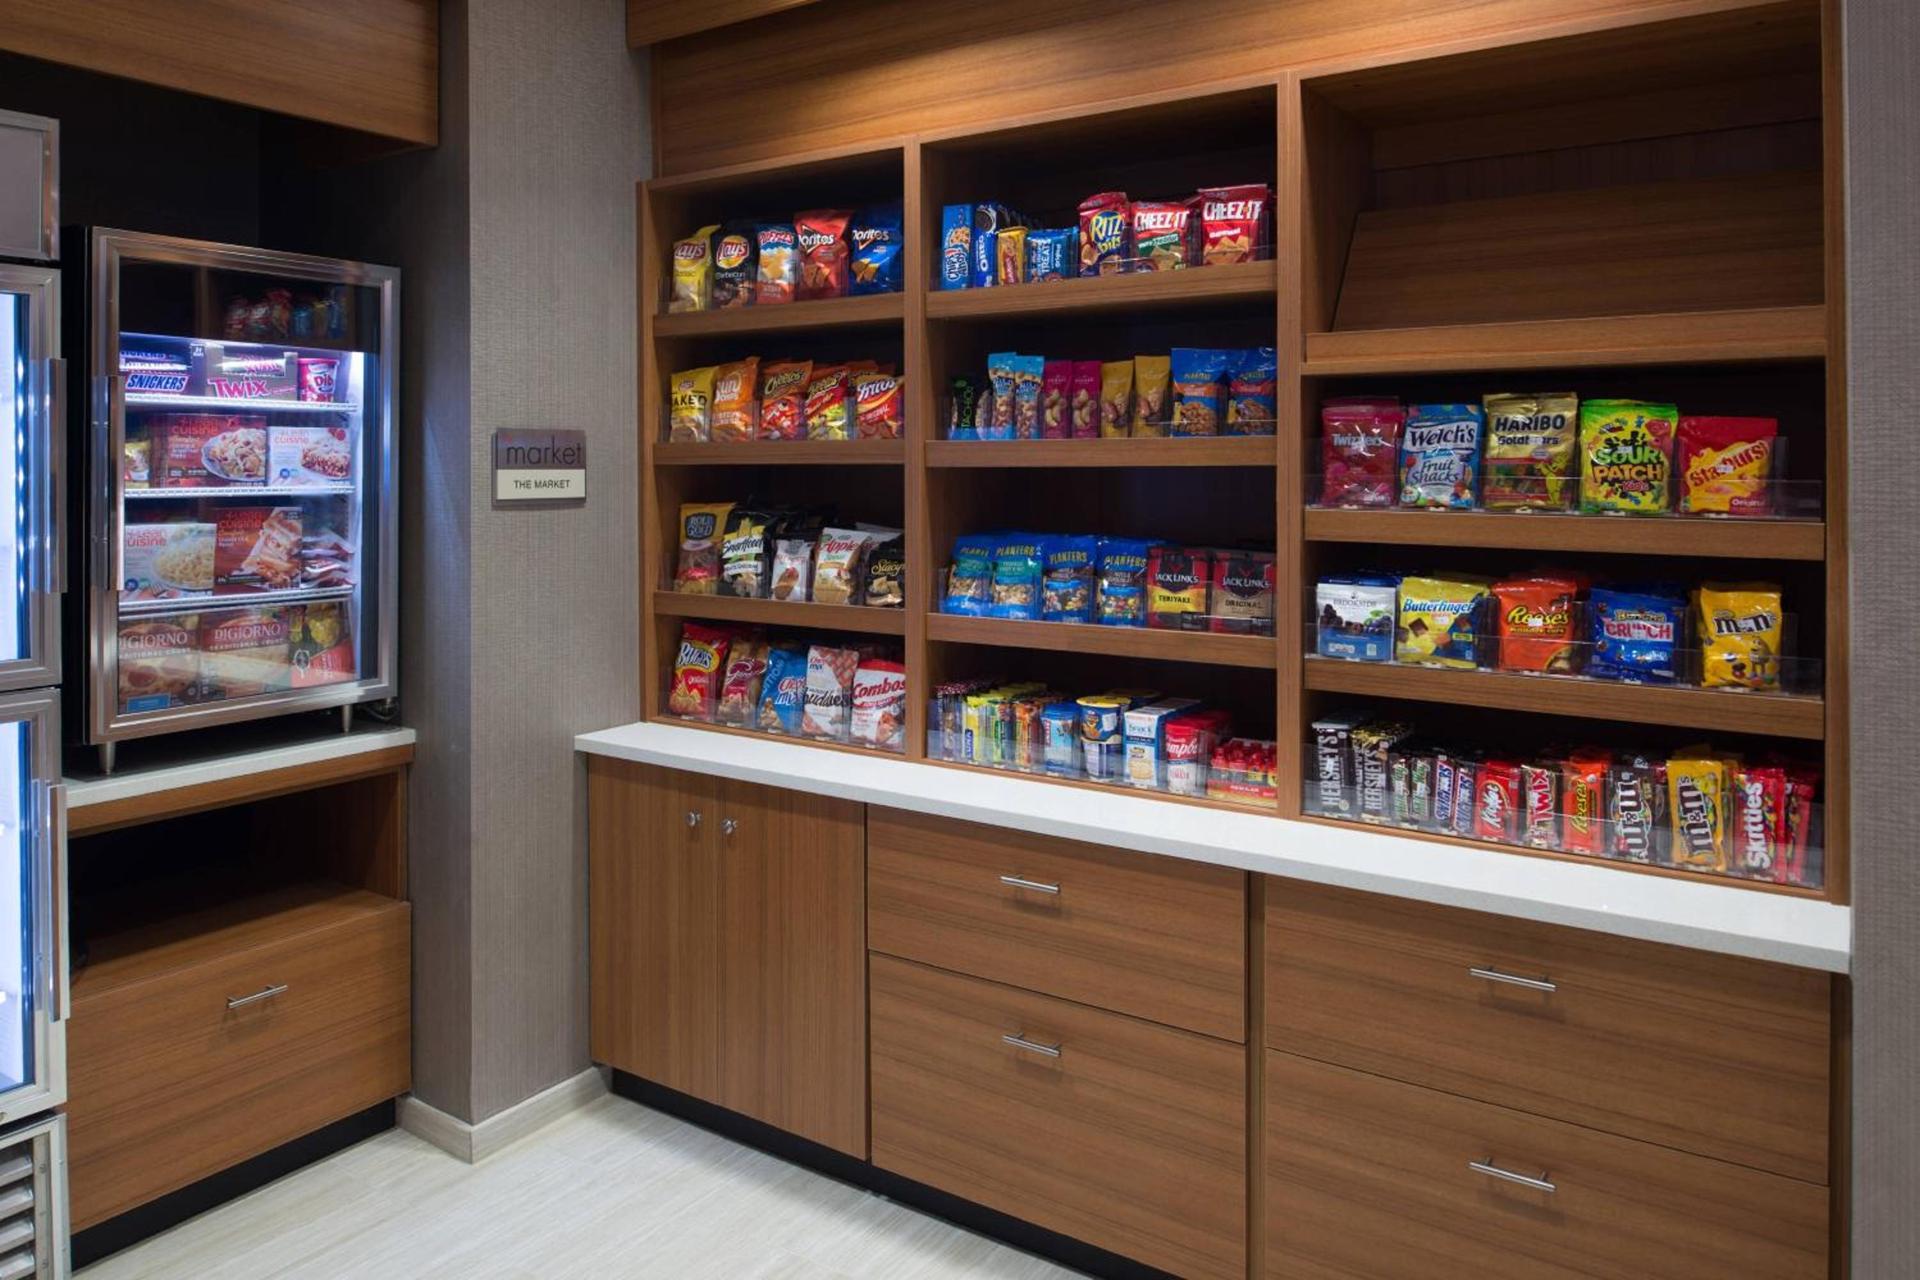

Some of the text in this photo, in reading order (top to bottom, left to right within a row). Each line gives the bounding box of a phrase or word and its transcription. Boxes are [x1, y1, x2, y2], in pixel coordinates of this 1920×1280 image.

[1091, 213, 1125, 238] RITZ
[978, 235, 989, 272] OREO
[126, 374, 187, 391] SNICKERS
[673, 394, 707, 406] AKED
[1494, 414, 1566, 431] HARIBO
[1409, 425, 1470, 446] Welch's
[506, 434, 582, 465] market
[1596, 445, 1658, 465] SOUR
[1421, 460, 1454, 471] Fruit
[1593, 464, 1663, 486] PATCH
[1689, 442, 1768, 487] Staburst
[513, 479, 571, 489] THE MARKET
[1411, 470, 1458, 485] Snacks
[1103, 555, 1147, 568] PLANTERS
[1403, 598, 1476, 615] Butterfinger
[1508, 605, 1569, 625] Reese's
[214, 623, 281, 641] DIGIORNO
[1318, 735, 1341, 805] HERSHEY'S
[1363, 749, 1382, 809] HERSHEY'S
[1437, 764, 1453, 820] SNICRS
[1455, 776, 1473, 833] SNICRS
[1570, 779, 1589, 834] Reese's
[1744, 783, 1770, 868] Skittles
